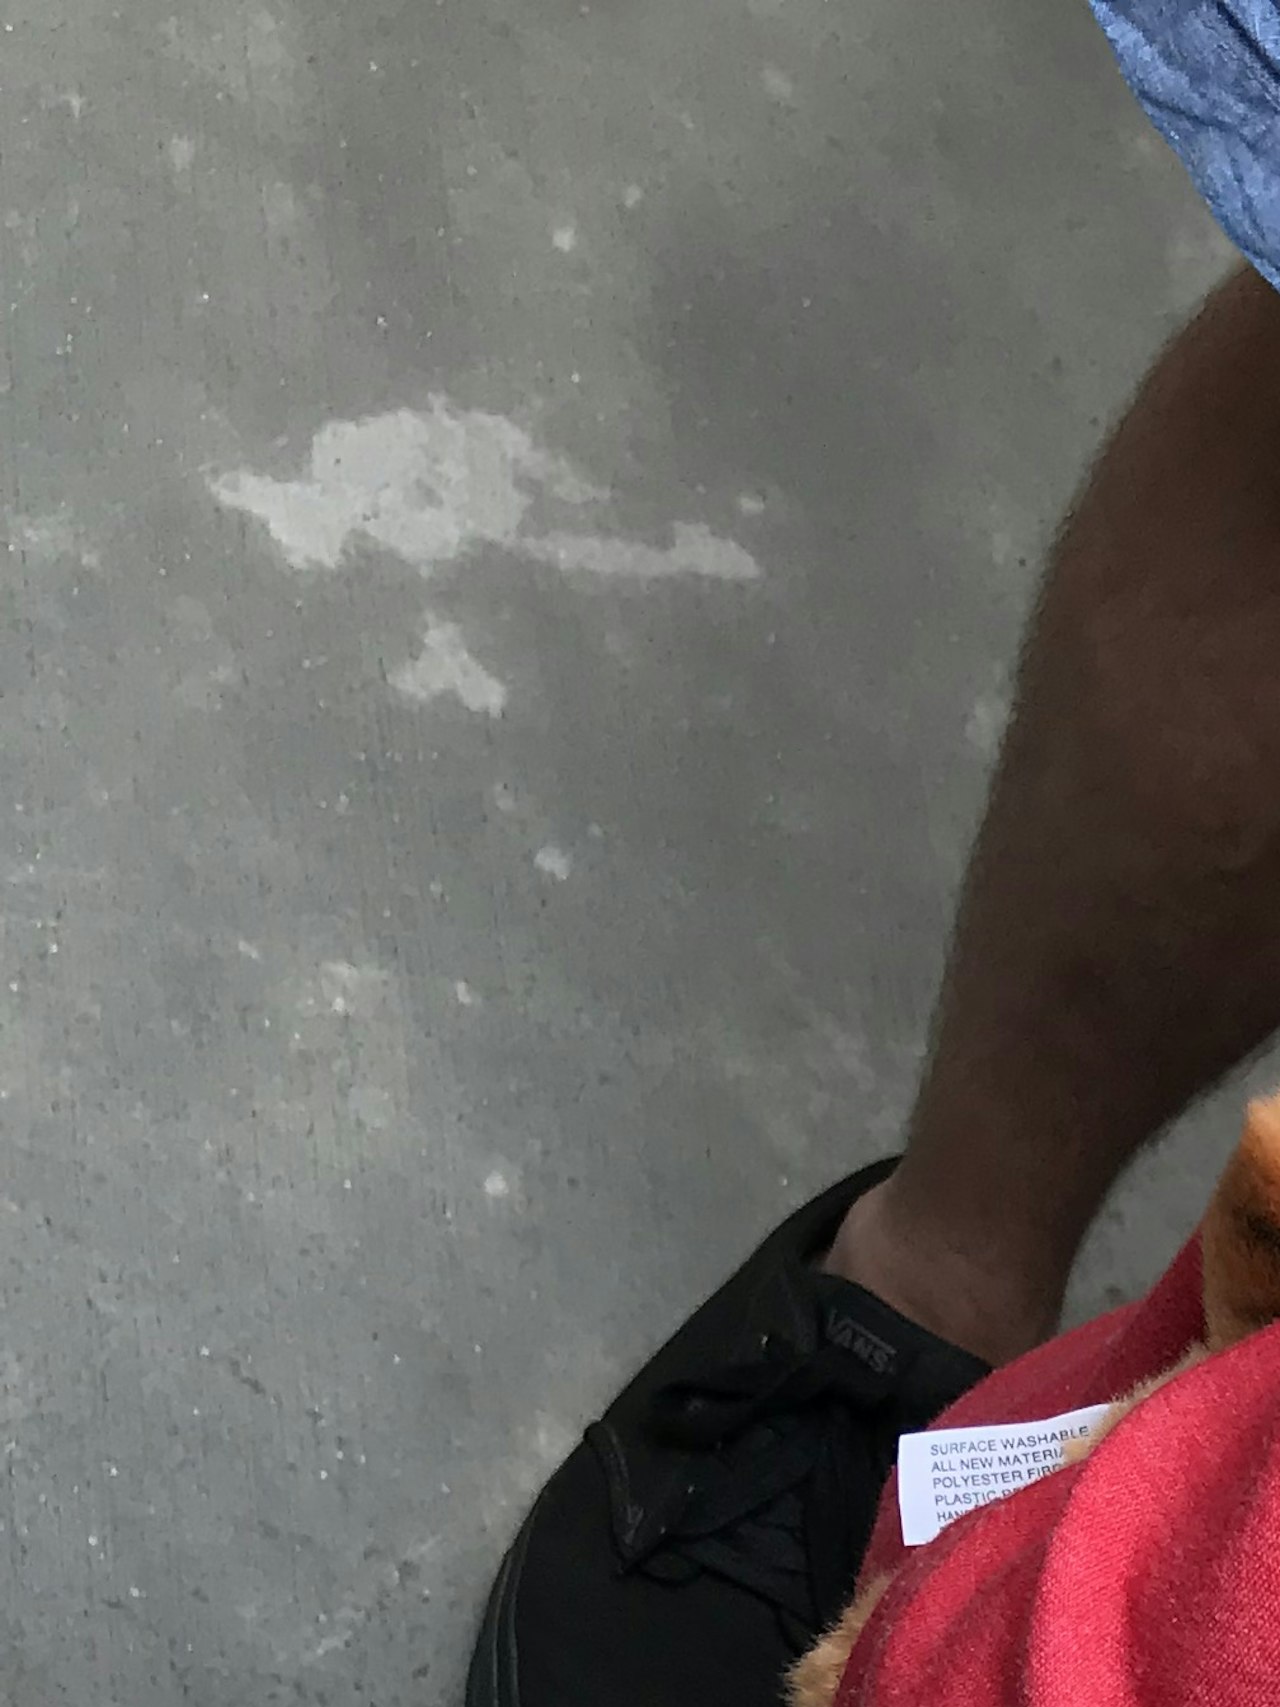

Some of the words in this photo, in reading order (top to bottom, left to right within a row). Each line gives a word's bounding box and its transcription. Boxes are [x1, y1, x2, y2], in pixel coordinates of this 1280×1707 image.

[825, 1306, 897, 1374] VANS
[930, 1438, 997, 1457] SURFACE
[1000, 1425, 1090, 1450] WASHABLE
[931, 1460, 957, 1473] ALL
[960, 1456, 994, 1470] NEW
[932, 1469, 1023, 1489] POLYESTER
[934, 1489, 997, 1507] PLASTIC
[936, 1508, 971, 1523] HAN
